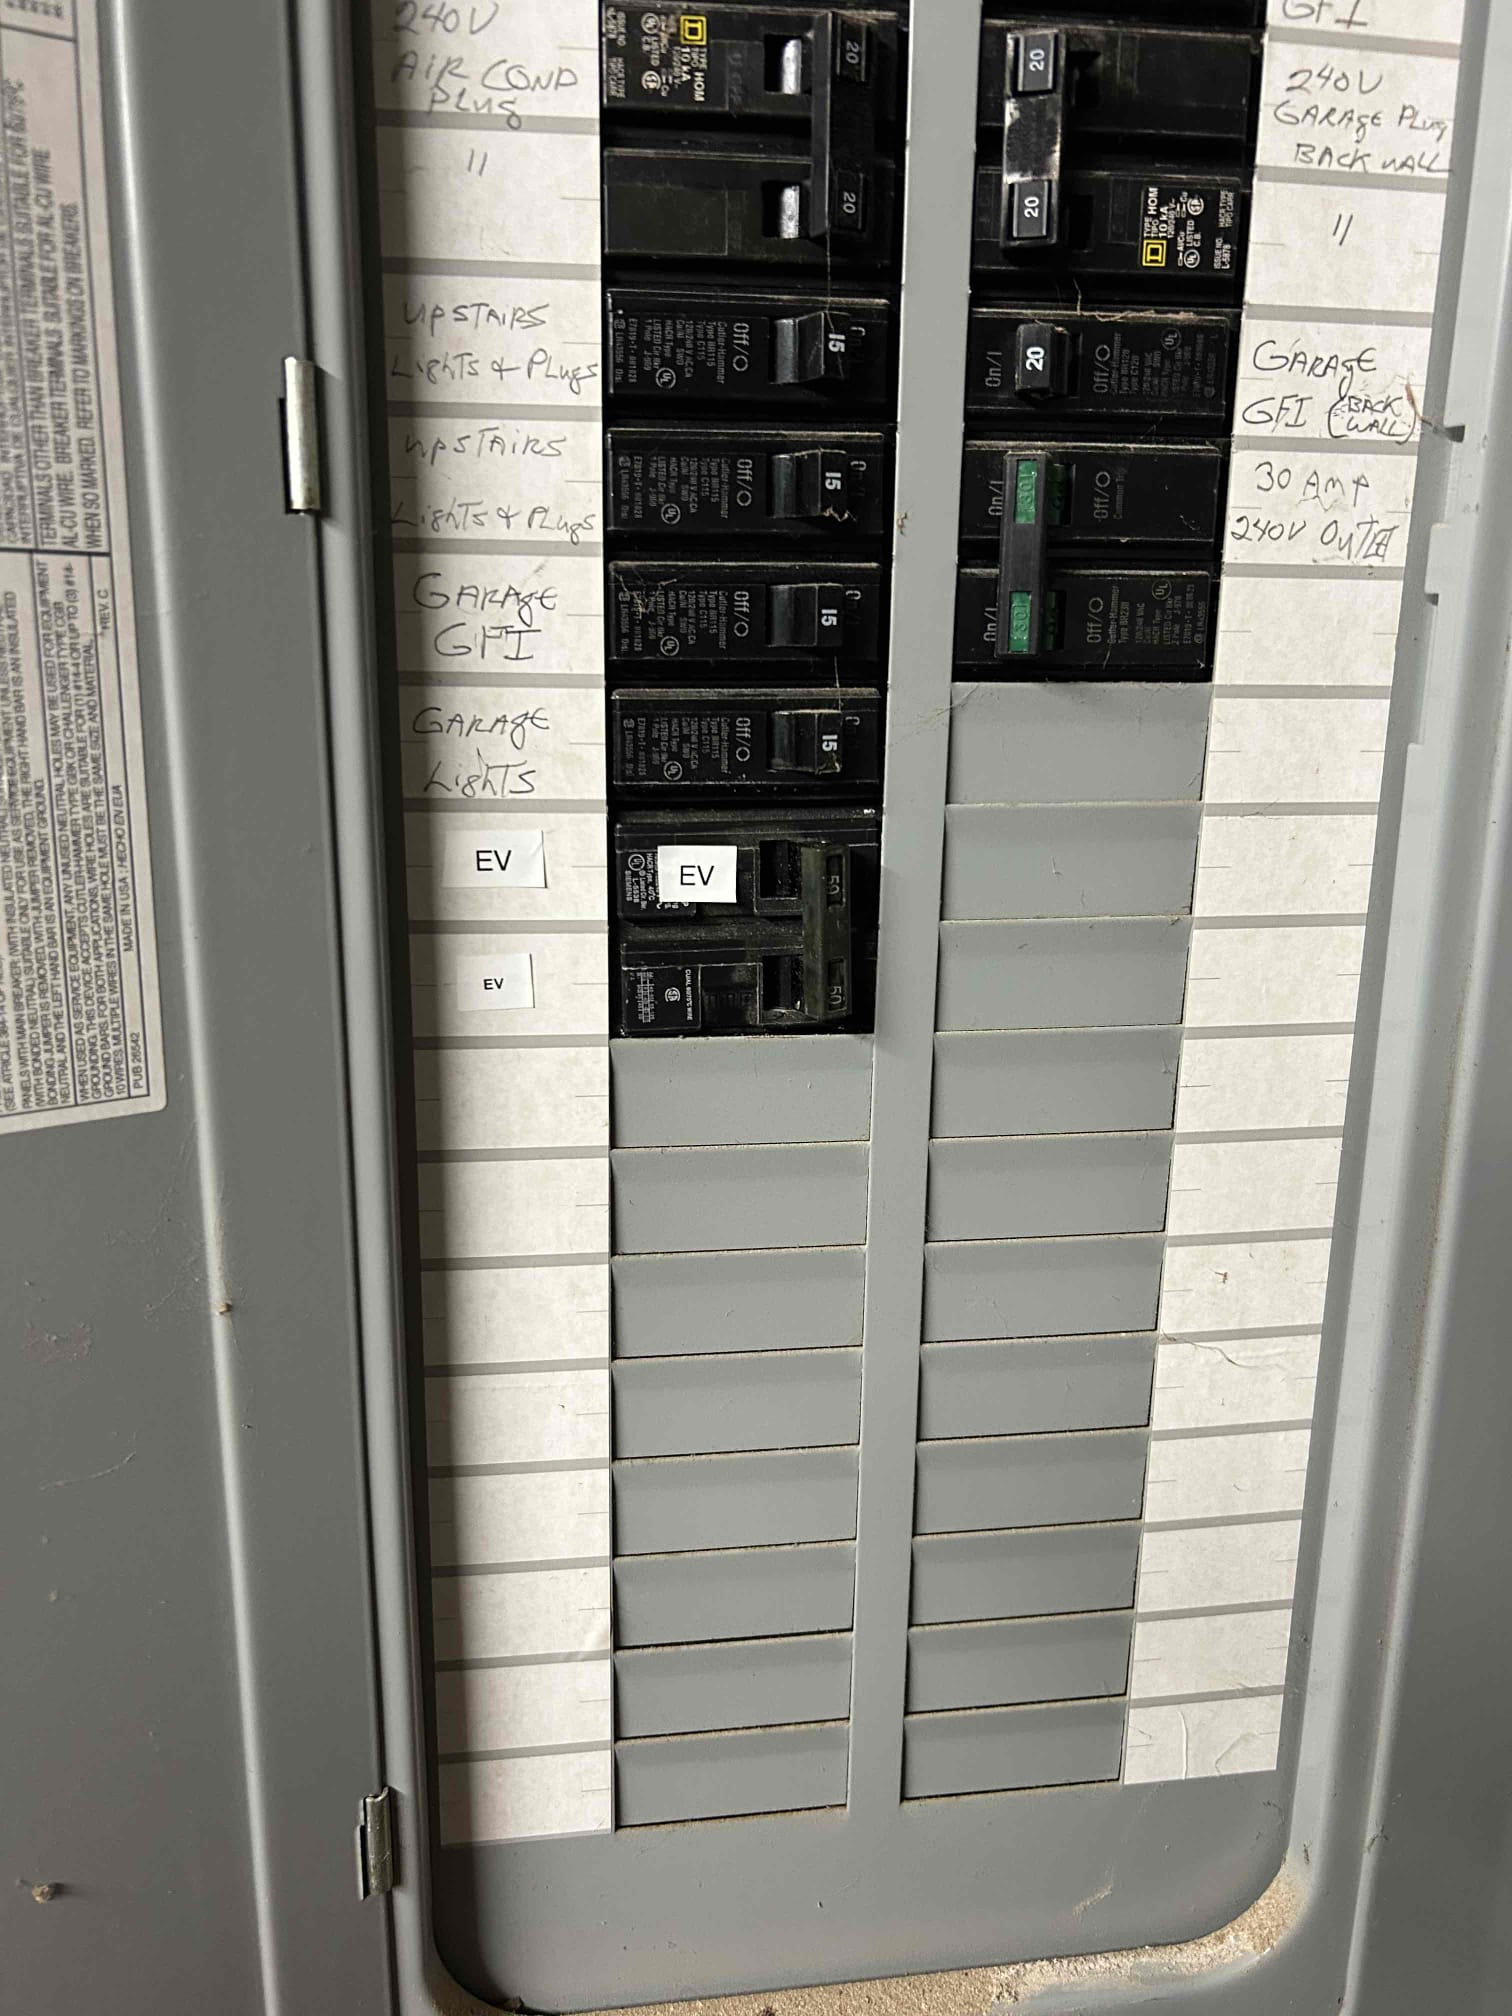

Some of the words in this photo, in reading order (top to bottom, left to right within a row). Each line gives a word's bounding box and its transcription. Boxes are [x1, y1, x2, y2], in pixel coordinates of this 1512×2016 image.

[392, 1, 500, 35] 240V
[682, 46, 691, 62] 10
[845, 41, 860, 64] 20
[1028, 48, 1045, 72] 20
[481, 59, 578, 91] COND
[693, 71, 705, 102] HOM
[1294, 142, 1372, 174] BACK
[841, 191, 857, 214] 20
[1023, 196, 1039, 218] 20
[1147, 187, 1159, 215] HOM
[1159, 206, 1169, 221] kA
[1143, 216, 1153, 238] TYPE
[1159, 223, 1168, 239] 10
[1186, 219, 1195, 247] LISTED
[717, 320, 728, 384] Cutler-Hammer
[828, 333, 845, 353] 15
[1025, 346, 1045, 372] 20
[70, 367, 89, 383] TO
[72, 388, 93, 429] REFER
[1241, 393, 1313, 428] GFI
[49, 401, 73, 463] BREAKER
[29, 423, 51, 470] OTHER
[825, 472, 842, 490] 15
[1255, 462, 1293, 493] 30
[34, 473, 58, 545] TERMINALS
[82, 491, 101, 509] SO
[83, 511, 104, 549] WHEN
[1230, 515, 1307, 542] 240V
[96, 588, 108, 598] C
[97, 601, 110, 629] REV.
[718, 591, 729, 649] Cutler-Hammer
[821, 608, 838, 627] 15
[42, 632, 54, 657] FOR
[434, 621, 542, 661] GFI
[44, 660, 57, 692] USED
[16, 715, 29, 745] HAND
[48, 711, 60, 736] MAY
[822, 734, 838, 752] 15
[51, 738, 64, 777] HOLES
[34, 779, 48, 828] GROUND
[54, 780, 68, 831] NEUTRAL
[67, 787, 79, 816] TYPE
[80, 789, 92, 810] ARE
[110, 784, 122, 806] EUA
[112, 809, 123, 824] EN
[82, 815, 95, 851] HOLES
[114, 827, 127, 867] HECHO
[58, 834, 72, 879] UNUSED
[85, 855, 97, 881] WIRE
[475, 849, 512, 871] EV
[98, 860, 110, 889] HOLE
[118, 877, 129, 899] USA
[625, 870, 633, 902] SIEMENS
[680, 864, 714, 886] EV
[830, 875, 842, 895] 50
[62, 881, 74, 903] ANY
[101, 892, 113, 921] SAME
[120, 904, 131, 915] IN
[77, 916, 91, 964] ACCEPTS
[121, 919, 133, 951] MADE
[48, 951, 60, 979] HAND
[106, 960, 118, 993] WIRES
[50, 983, 62, 1007] LEFT
[69, 975, 83, 1019] SERVICE
[81, 967, 94, 1006] DEVICE
[482, 977, 504, 990] EV
[829, 985, 842, 1006] 50
[53, 1010, 64, 1030] THE
[84, 1009, 96, 1032] THIS
[96, 995, 108, 1018] FOR
[109, 995, 122, 1045] MULTIPLE
[28, 1031, 42, 1075] BONDED
[74, 1038, 87, 1067] USED
[43, 1059, 57, 1104] BONDING
[56, 1059, 69, 1103] NEUTRAL
[77, 1069, 89, 1101] WHEN
[101, 1052, 114, 1097] GROUND
[132, 1065, 144, 1088] PUB
[18, 1070, 32, 1108] PANELS
